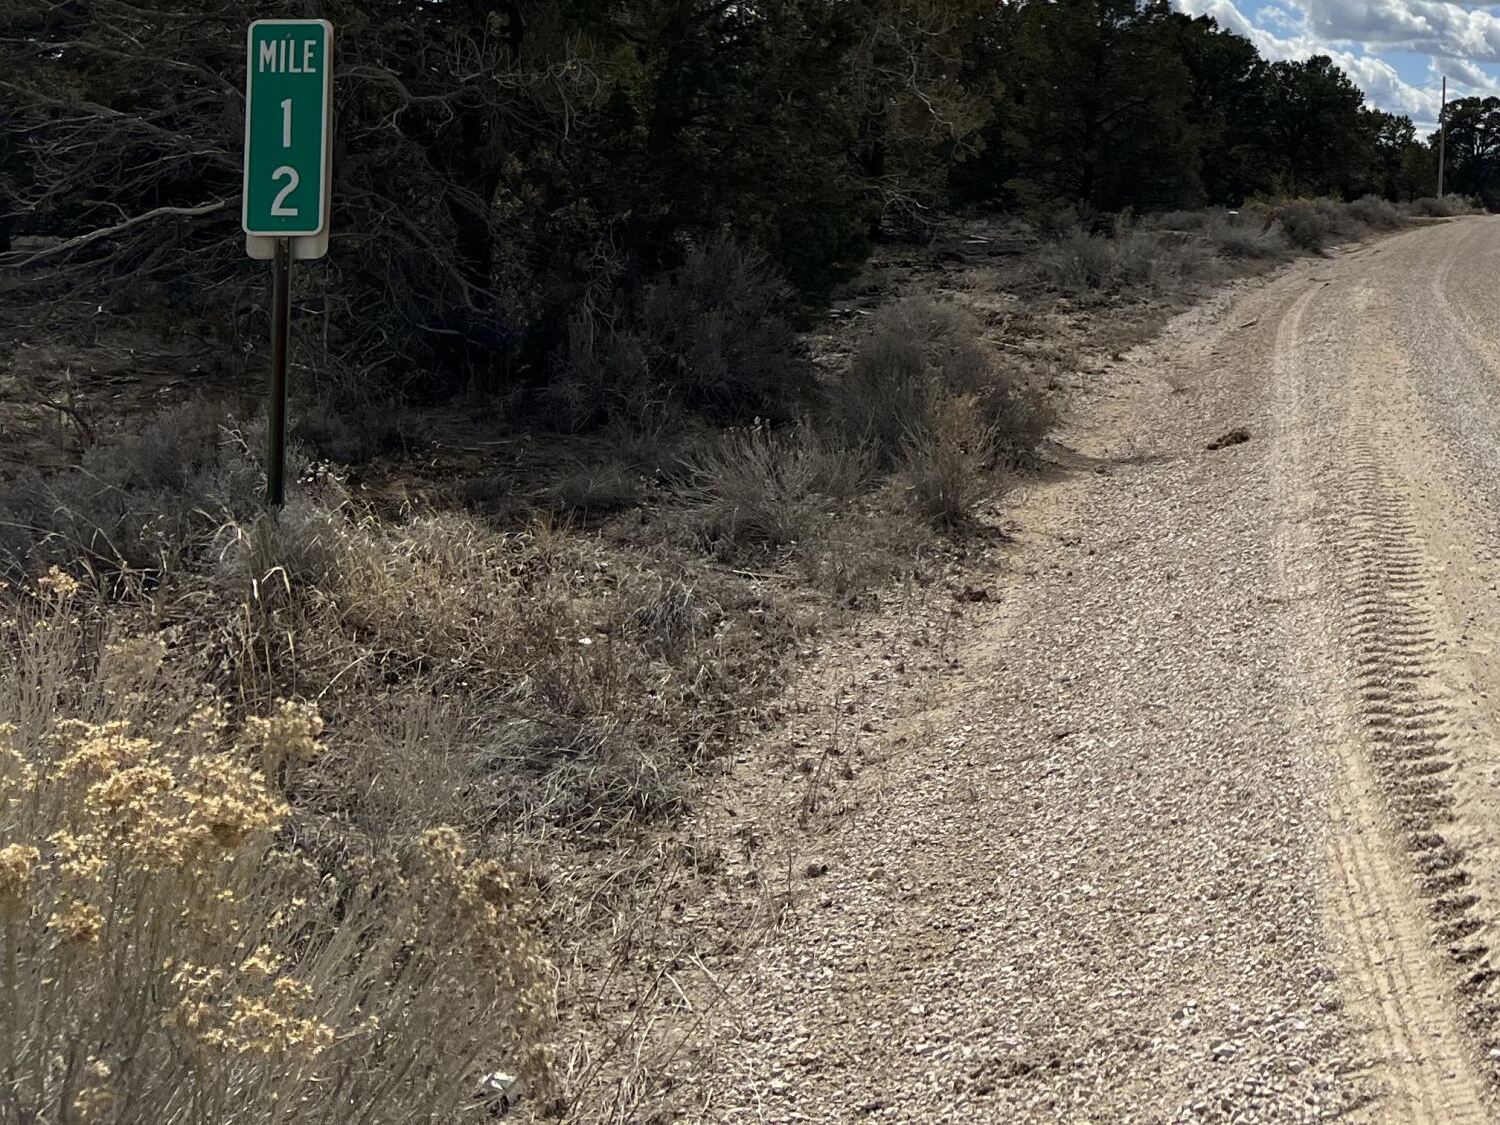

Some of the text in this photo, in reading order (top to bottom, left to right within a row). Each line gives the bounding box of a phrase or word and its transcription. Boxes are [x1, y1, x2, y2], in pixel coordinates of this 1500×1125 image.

[259, 40, 316, 73] MILE
[281, 99, 292, 147] 1
[271, 166, 299, 216] 2
